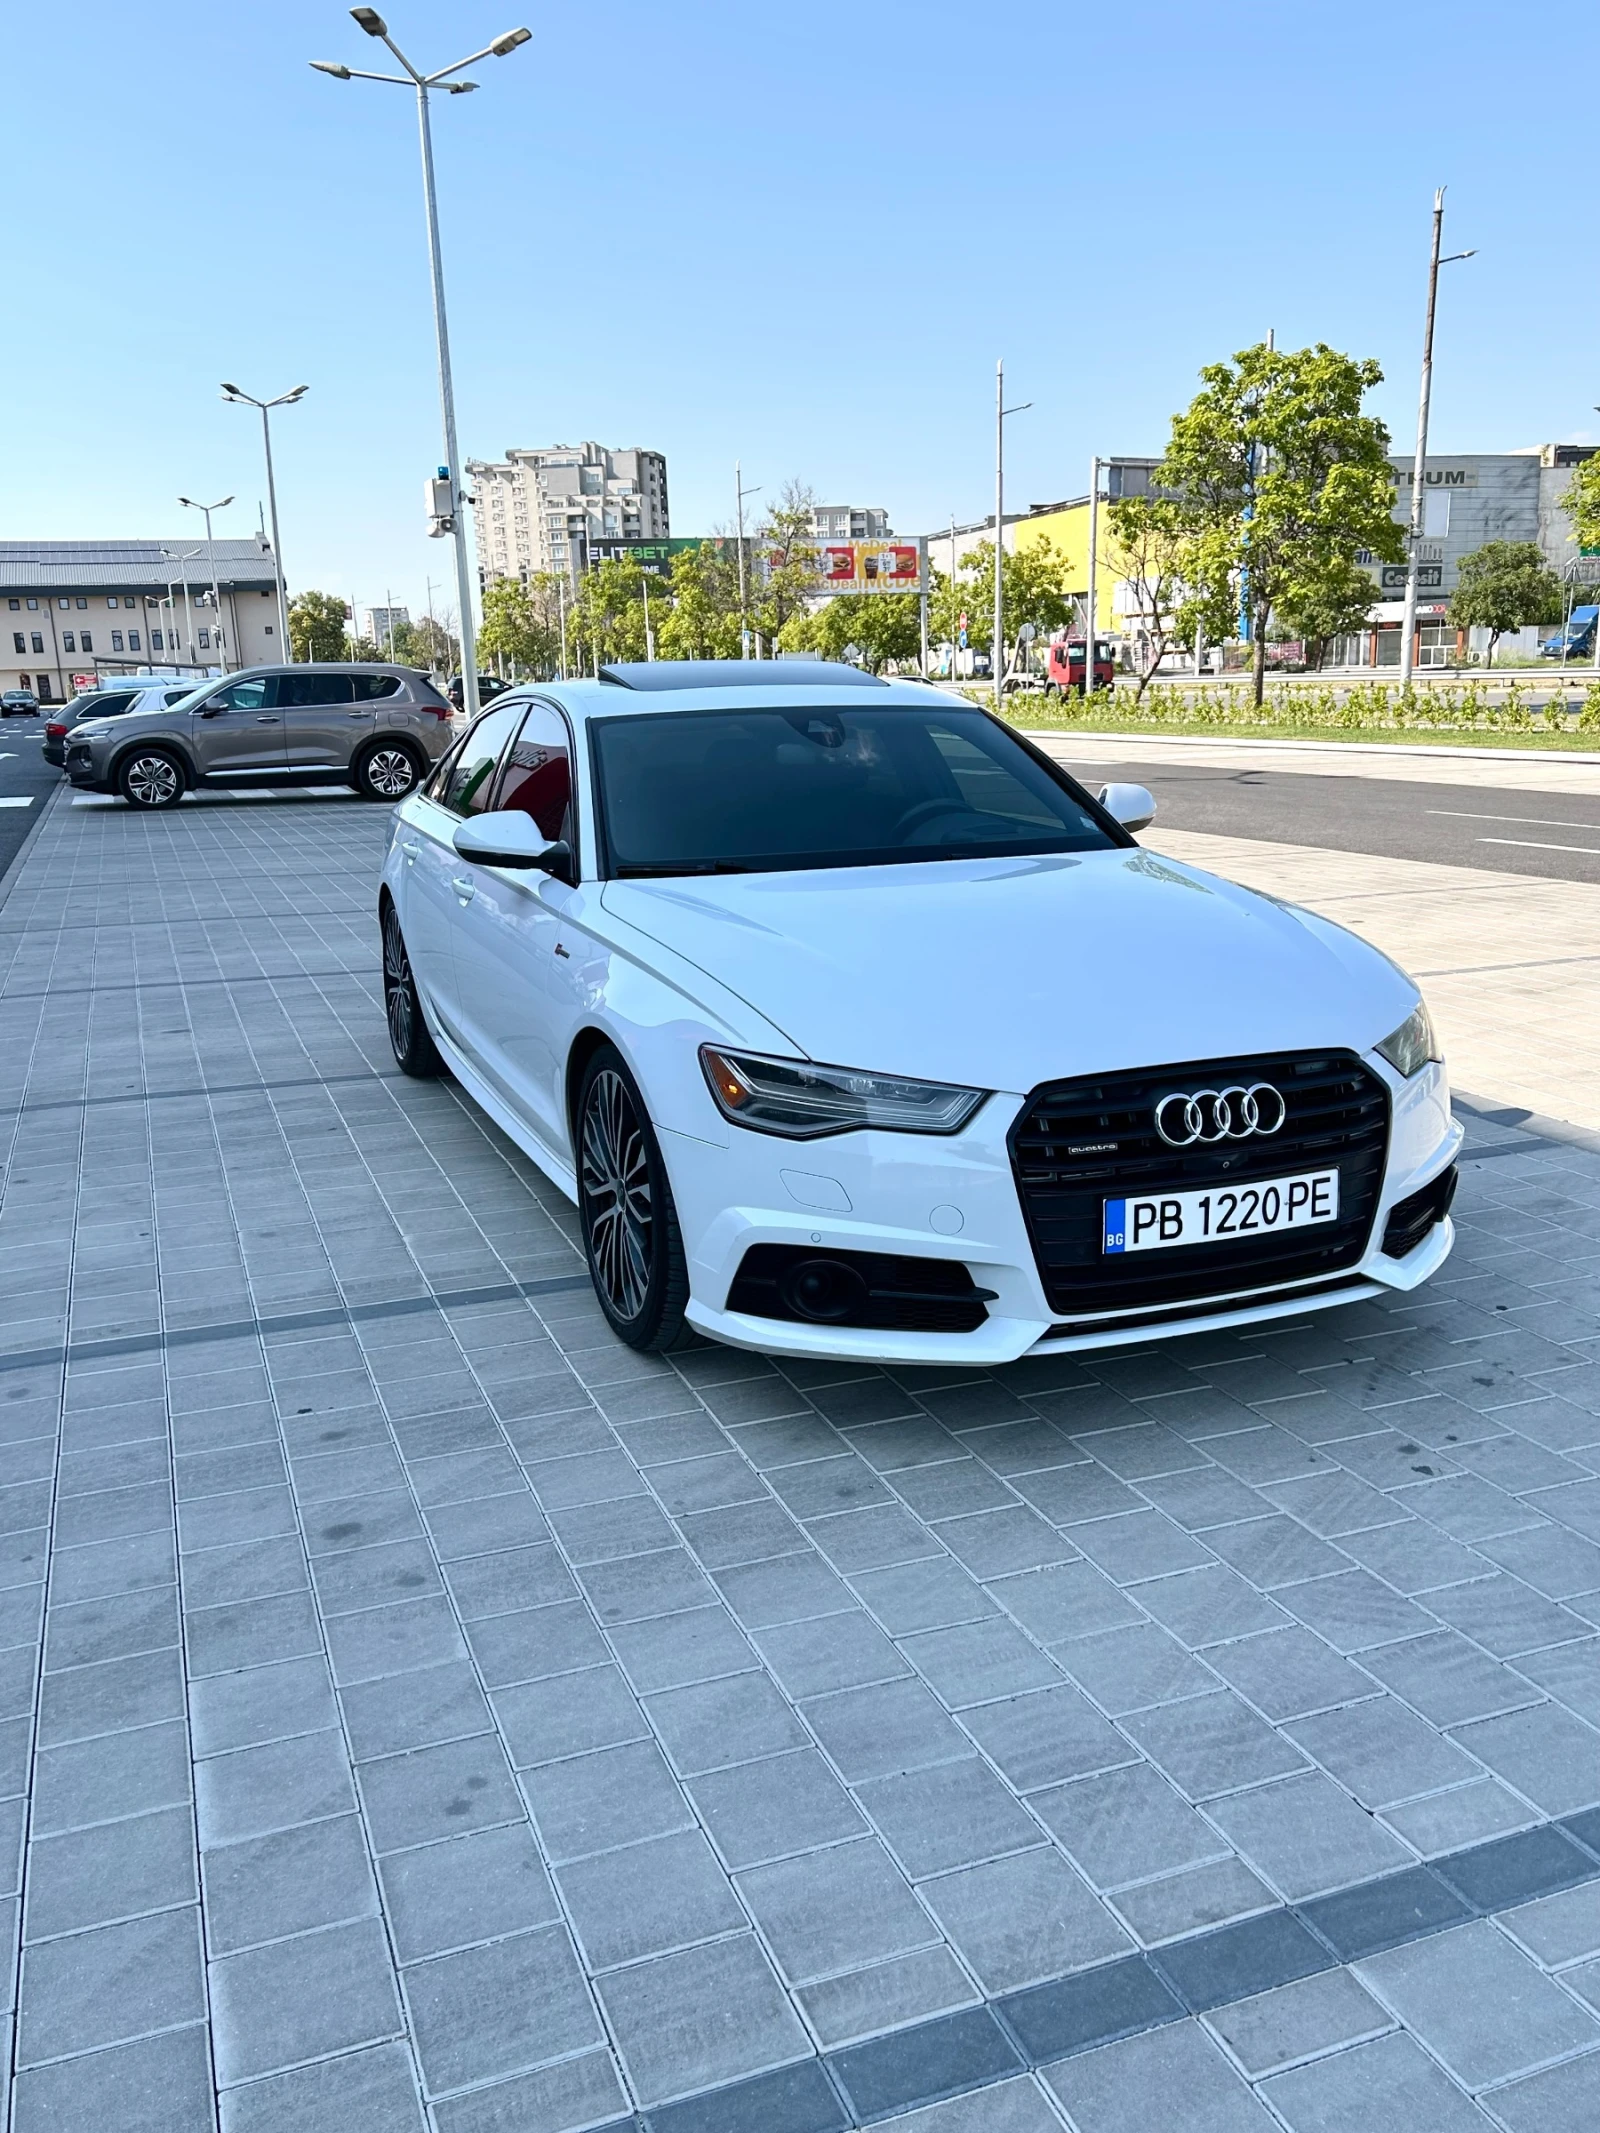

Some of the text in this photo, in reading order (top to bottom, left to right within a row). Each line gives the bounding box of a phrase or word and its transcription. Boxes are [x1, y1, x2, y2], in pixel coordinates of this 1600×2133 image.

[1071, 1144, 1116, 1154] quattro
[1133, 1200, 1183, 1244] PB
[1107, 1233, 1124, 1246] BG
